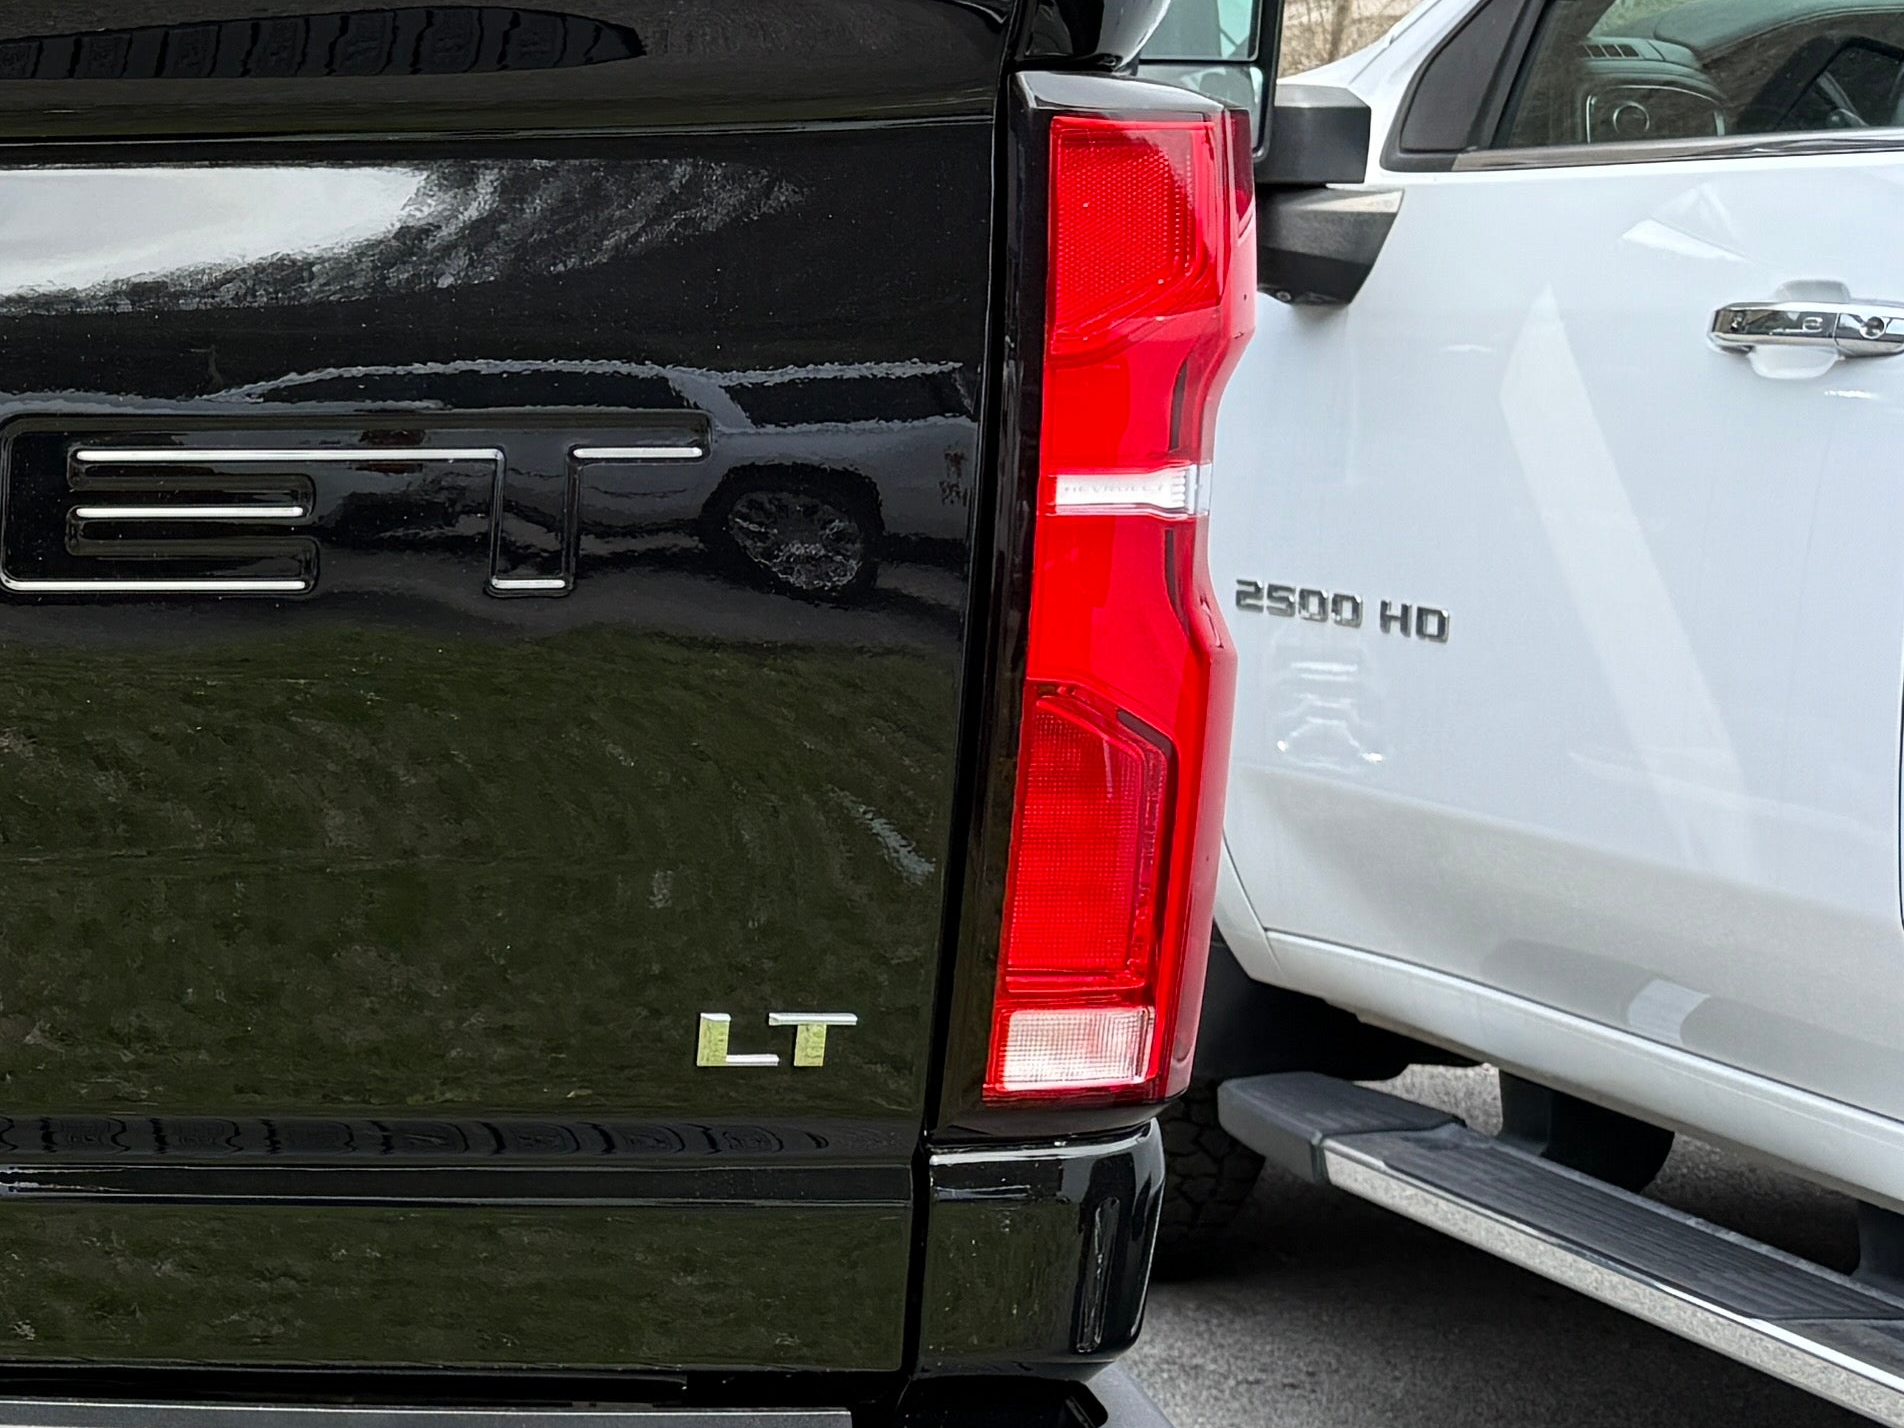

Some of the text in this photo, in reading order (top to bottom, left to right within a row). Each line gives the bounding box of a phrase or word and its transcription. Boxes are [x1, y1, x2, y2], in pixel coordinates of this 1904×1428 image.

[1235, 579, 1450, 644] 2500 HD
[697, 1012, 857, 1066] LT
